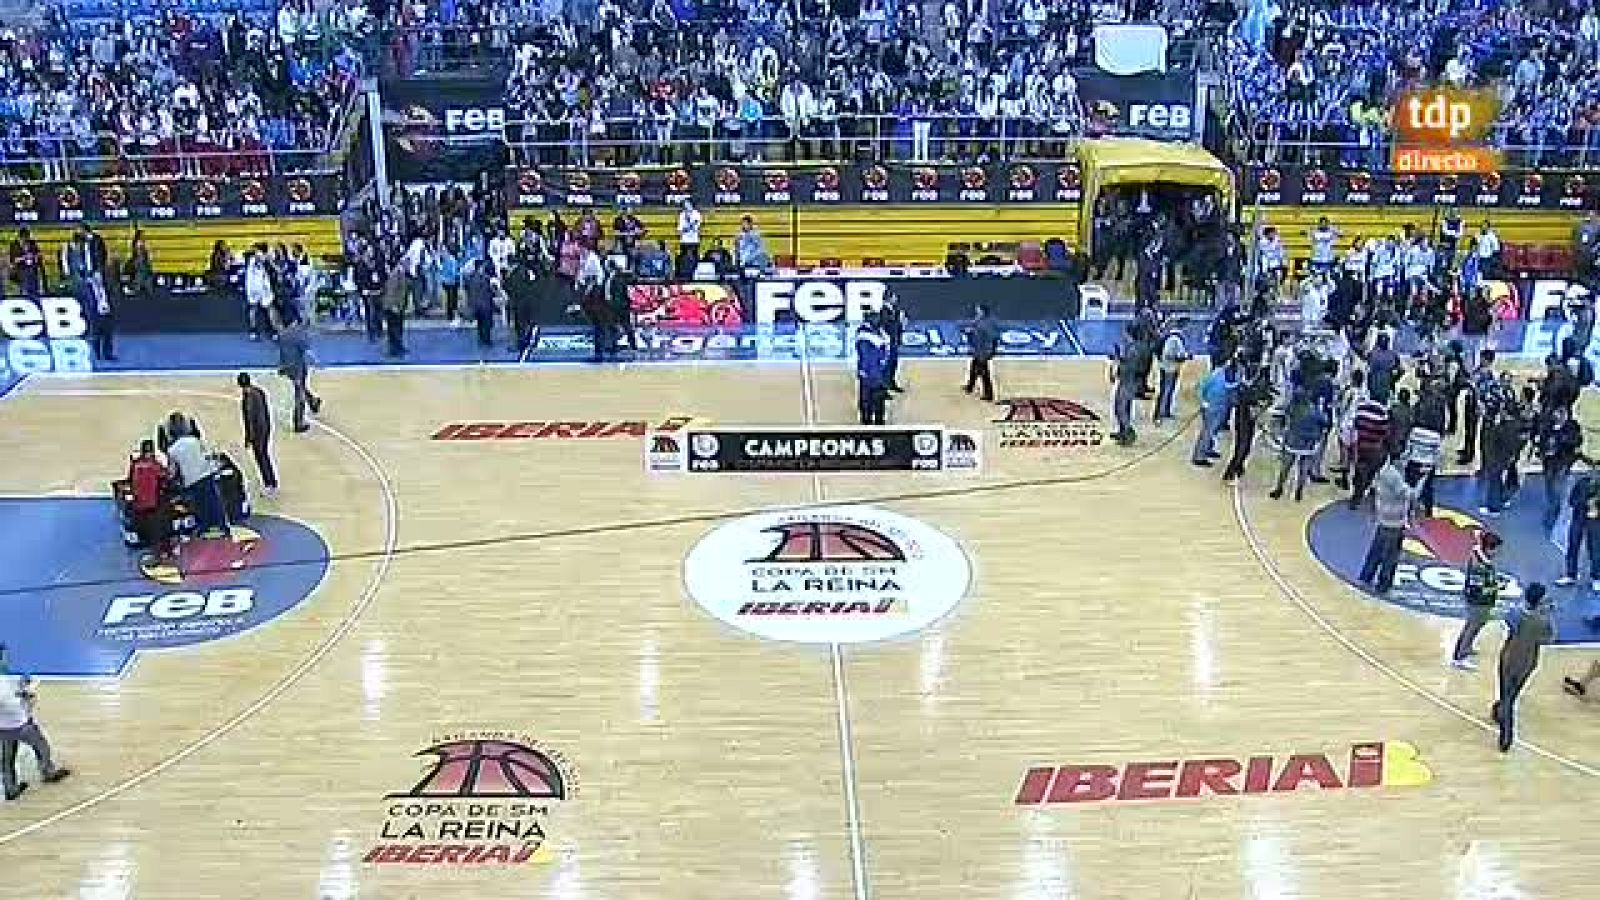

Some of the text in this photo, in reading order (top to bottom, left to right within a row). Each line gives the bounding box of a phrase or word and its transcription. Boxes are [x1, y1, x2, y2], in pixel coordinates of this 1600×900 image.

[744, 440, 886, 456] CAMPEONAS
[751, 578, 901, 592] LA REINA
[1016, 754, 1343, 804] IBERIA
[388, 803, 548, 817] COPA DE SM
[380, 820, 547, 839] LA REINA
